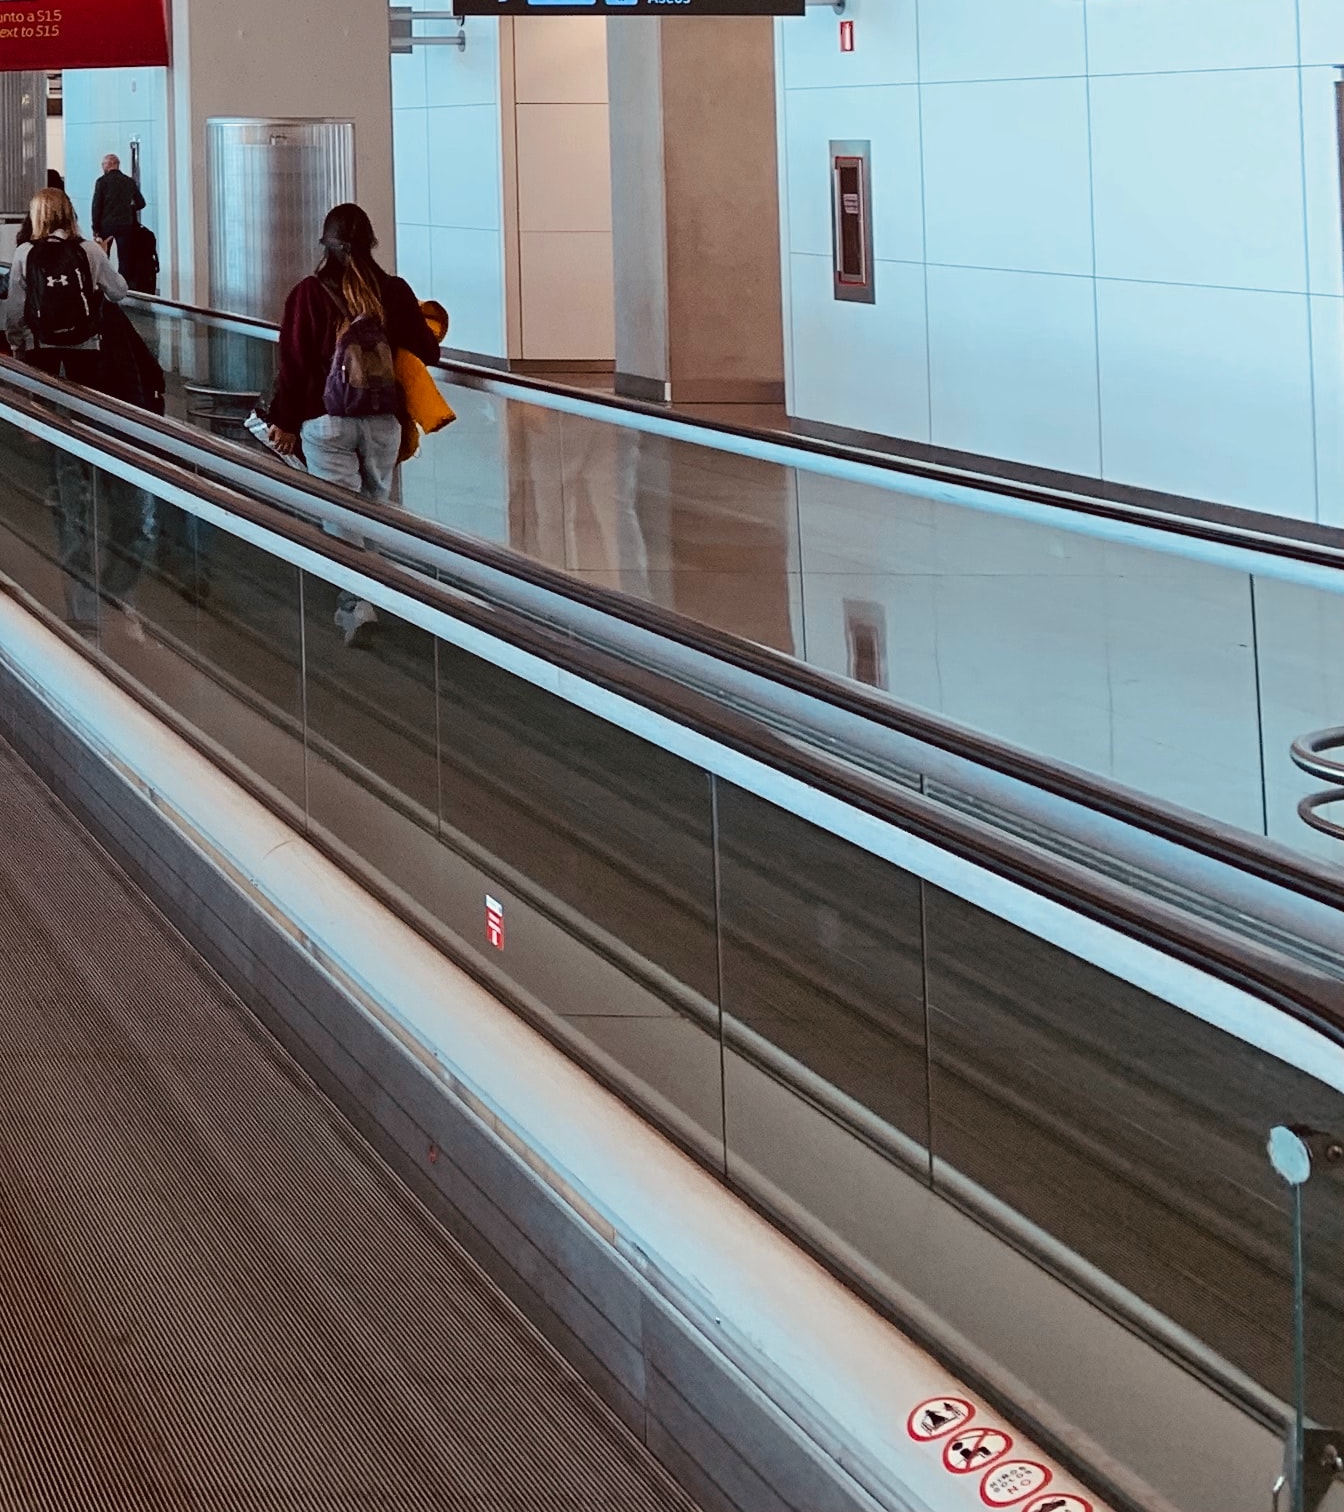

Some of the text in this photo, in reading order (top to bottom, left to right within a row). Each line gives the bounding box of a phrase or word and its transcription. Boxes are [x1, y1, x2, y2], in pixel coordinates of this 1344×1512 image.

[26, 12, 35, 22] a
[36, 9, 63, 22] S15
[21, 26, 34, 38] to
[35, 24, 60, 37] S15
